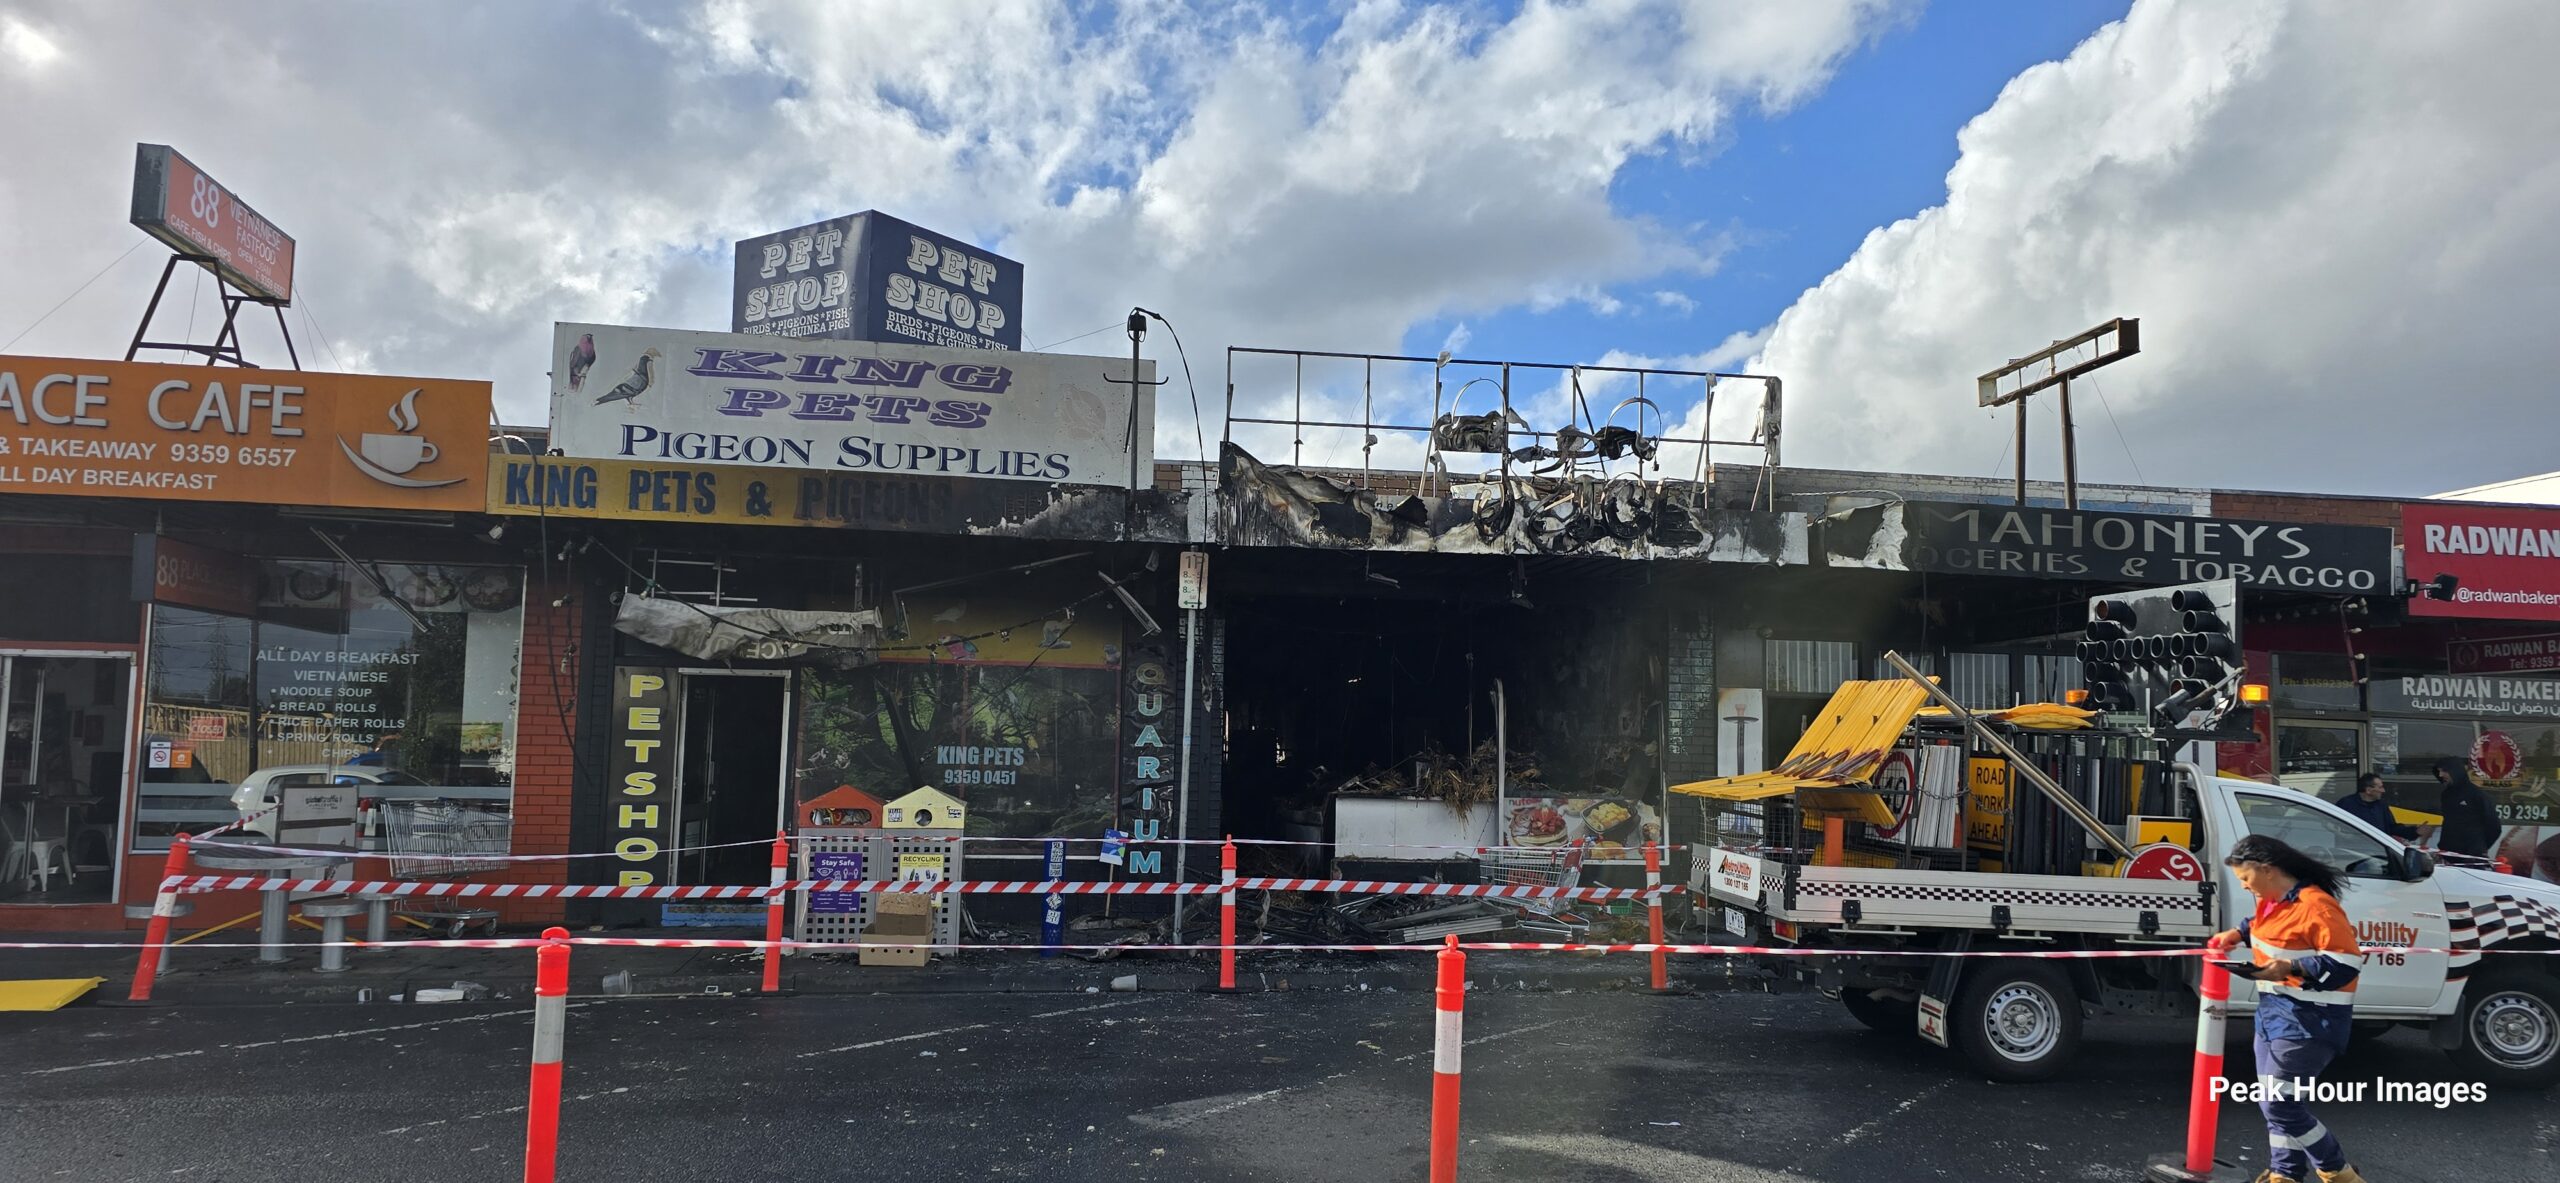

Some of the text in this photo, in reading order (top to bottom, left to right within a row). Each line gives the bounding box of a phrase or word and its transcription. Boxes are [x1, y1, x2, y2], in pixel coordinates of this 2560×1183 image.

[191, 173, 220, 228] 88
[230, 198, 281, 252] VIETNAMESE
[191, 227, 207, 245] FISH
[213, 242, 232, 263] CHIPS
[236, 226, 276, 265] FASTFOOD
[237, 247, 253, 265] OPEN
[760, 229, 843, 279] PET
[907, 235, 997, 295] PET
[745, 270, 848, 322] SHOP
[886, 272, 1006, 337] SHOP
[743, 323, 771, 335] BIRDS
[778, 313, 819, 330] PIGEONS
[826, 307, 848, 322] FISH
[790, 322, 827, 338] GUINEA
[828, 317, 850, 331] PIGS
[886, 320, 935, 343] RABBITS
[936, 334, 945, 346] &
[888, 310, 1009, 351] BIRDS PIGEONS FISH
[685, 346, 1013, 394] KING
[148, 380, 305, 437] CAFE
[716, 387, 992, 429] PETS
[19, 437, 156, 461] TAKEAWAY
[170, 443, 230, 464] 9359
[238, 447, 296, 467] 6557
[618, 423, 1070, 480] PIGEON SUPPLIES
[32, 467, 77, 484] DAY
[82, 469, 217, 490] BREAKFAST
[505, 462, 952, 524] KING PETS & PIGEONS
[1918, 506, 2310, 560] MAHONEYS
[2424, 524, 2560, 558] RADWAN
[156, 554, 179, 588] 88
[2119, 556, 2148, 578] &
[2172, 558, 2376, 591] TOBACCO
[256, 650, 420, 665] ALL DAY BREAKFAST
[2484, 640, 2543, 658] RADWAN
[2530, 657, 2554, 669] 9359
[294, 670, 388, 683] VIETNAMESE
[2402, 677, 2491, 698] RADWAN
[280, 687, 373, 697] NOODLE SOUP
[279, 702, 377, 713] BREAD ROLLS
[2512, 702, 2549, 716] رضوان
[278, 717, 405, 729] RICE PAPER ROLLS
[277, 733, 374, 743] SPRING ROLLS
[321, 748, 361, 759] CHIPS
[937, 745, 1025, 767] KING PETS
[944, 768, 1016, 785] 9359 0451
[1976, 767, 2006, 785] ROAD
[1975, 794, 2005, 812] WORK
[2495, 804, 2549, 820] 59 2394
[821, 859, 855, 867] Stay Safe
[2350, 920, 2419, 948] oUtility
[2377, 953, 2405, 967] 165
